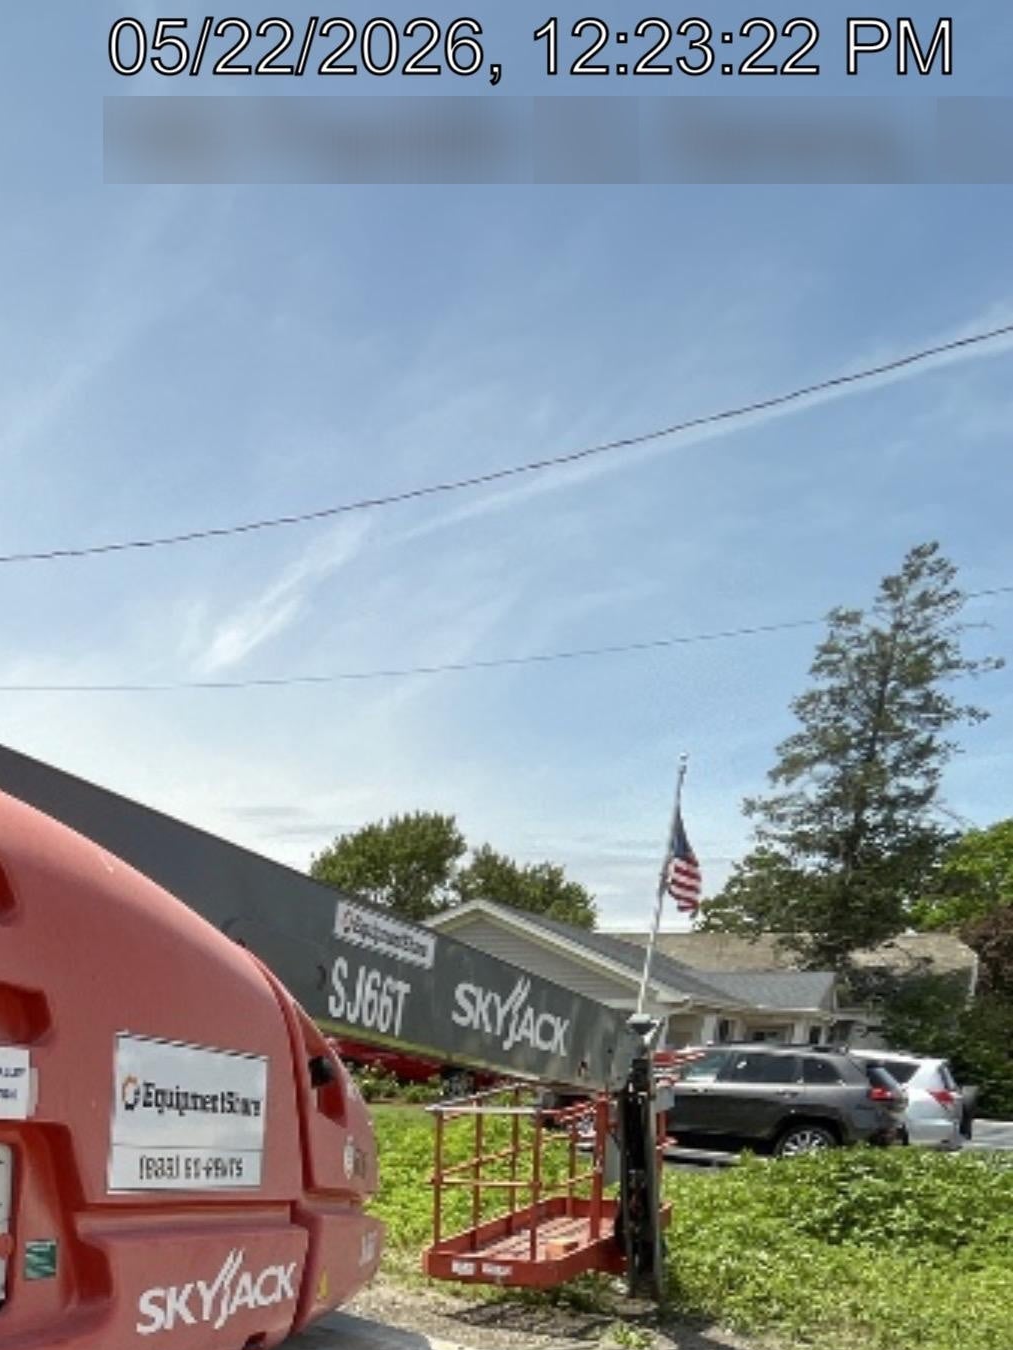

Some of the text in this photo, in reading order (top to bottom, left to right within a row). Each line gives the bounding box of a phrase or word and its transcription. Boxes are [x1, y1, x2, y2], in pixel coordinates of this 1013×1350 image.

[329, 956, 410, 1036] SJ66T
[452, 975, 571, 1056] SKYJACK
[136, 1247, 297, 1336] SKYJACK
